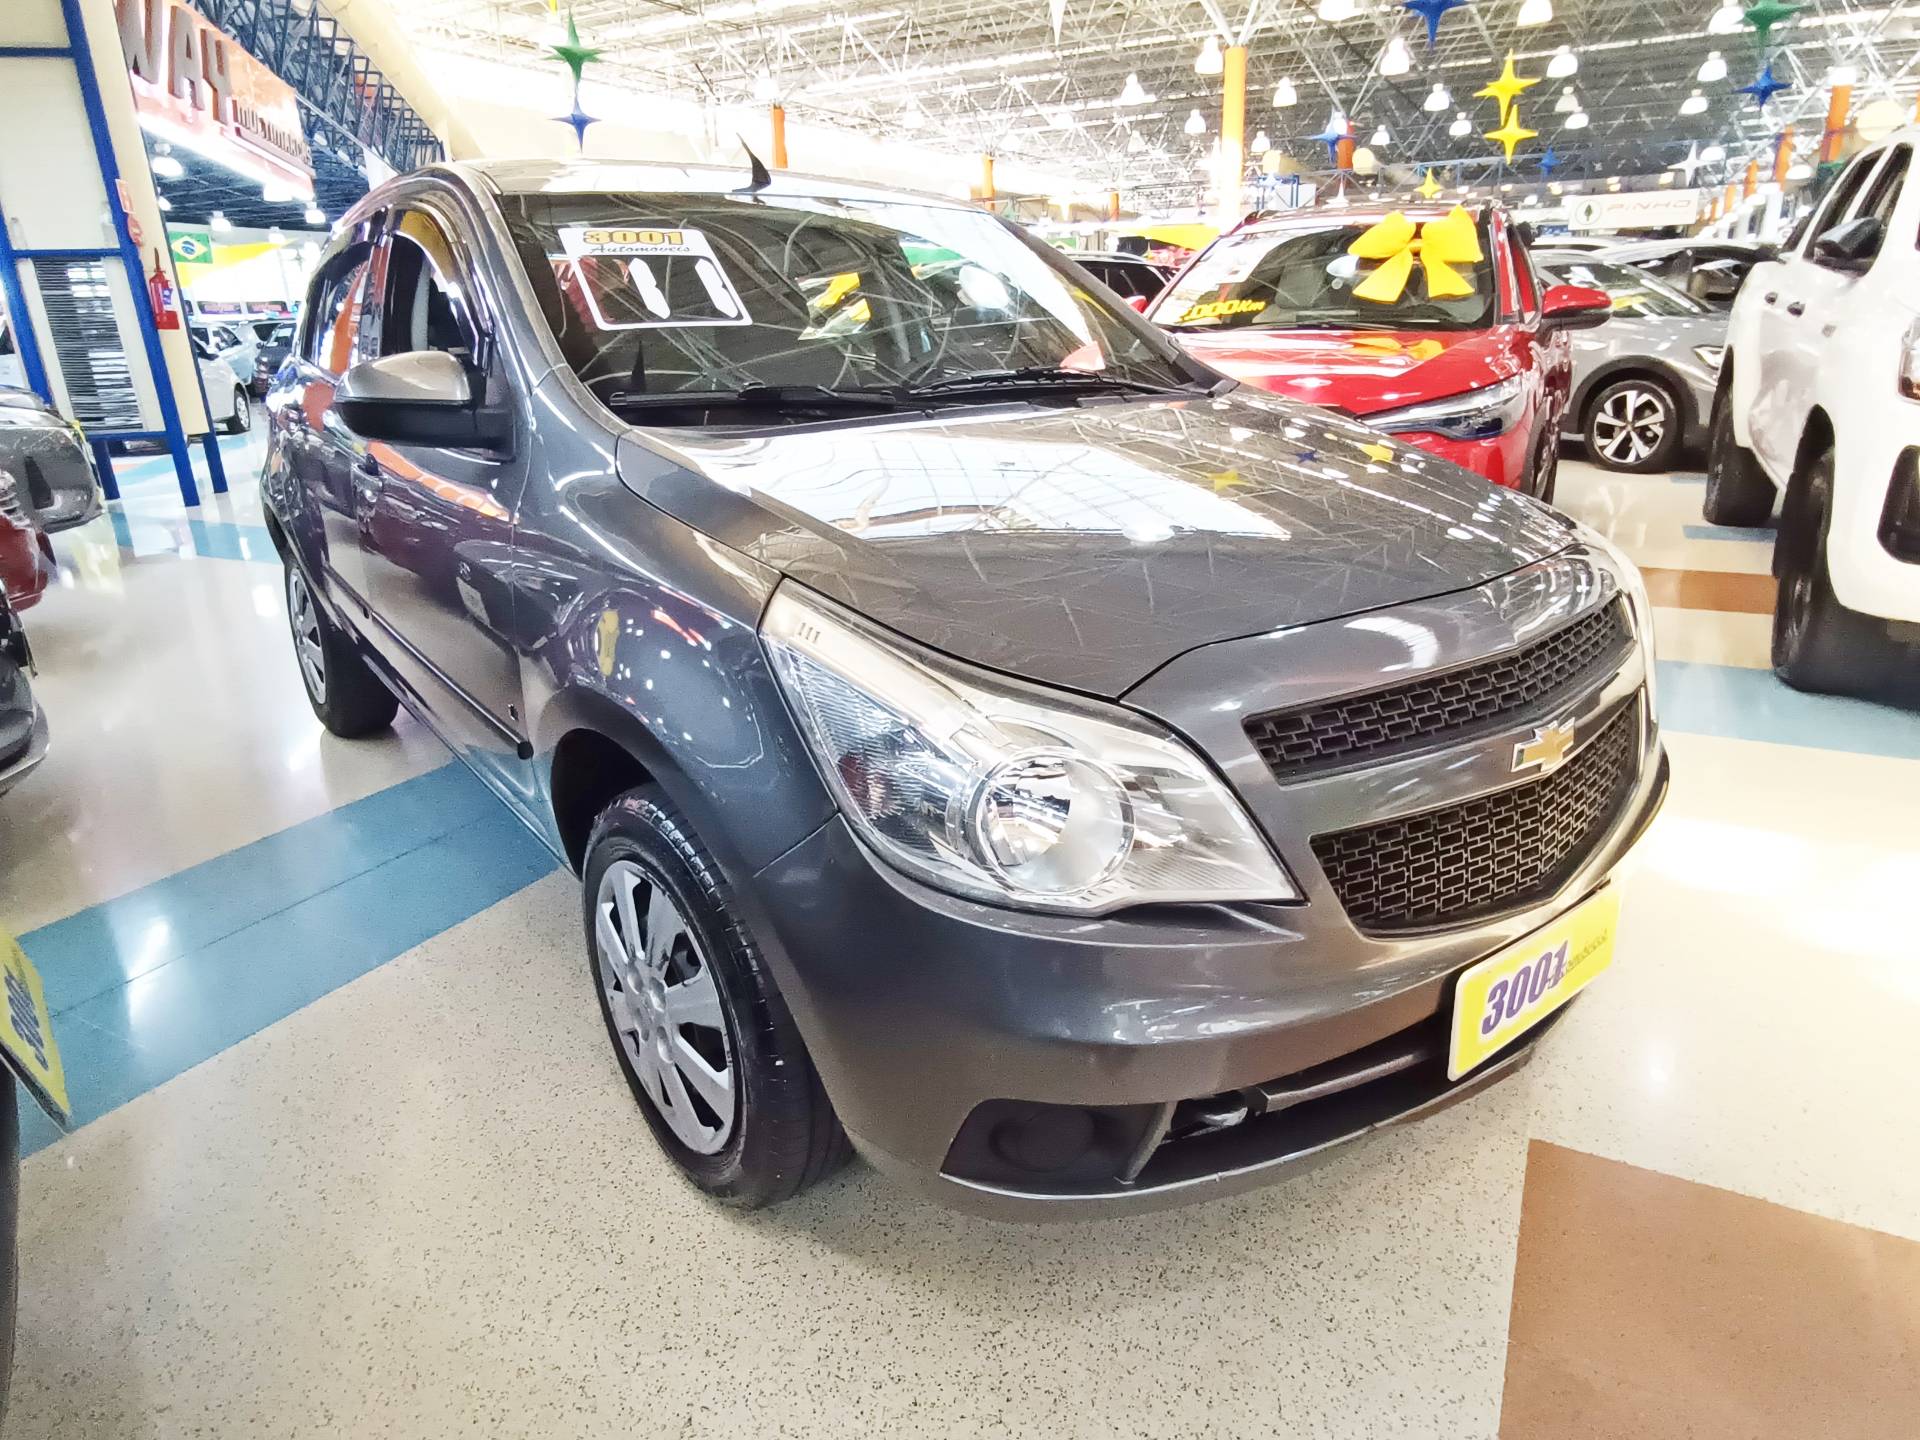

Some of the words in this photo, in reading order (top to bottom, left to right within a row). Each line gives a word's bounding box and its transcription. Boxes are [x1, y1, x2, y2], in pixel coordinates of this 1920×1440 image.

[1606, 199, 1691, 211] PINHO
[583, 230, 684, 246] 3001
[1481, 939, 1568, 1035] 3001
